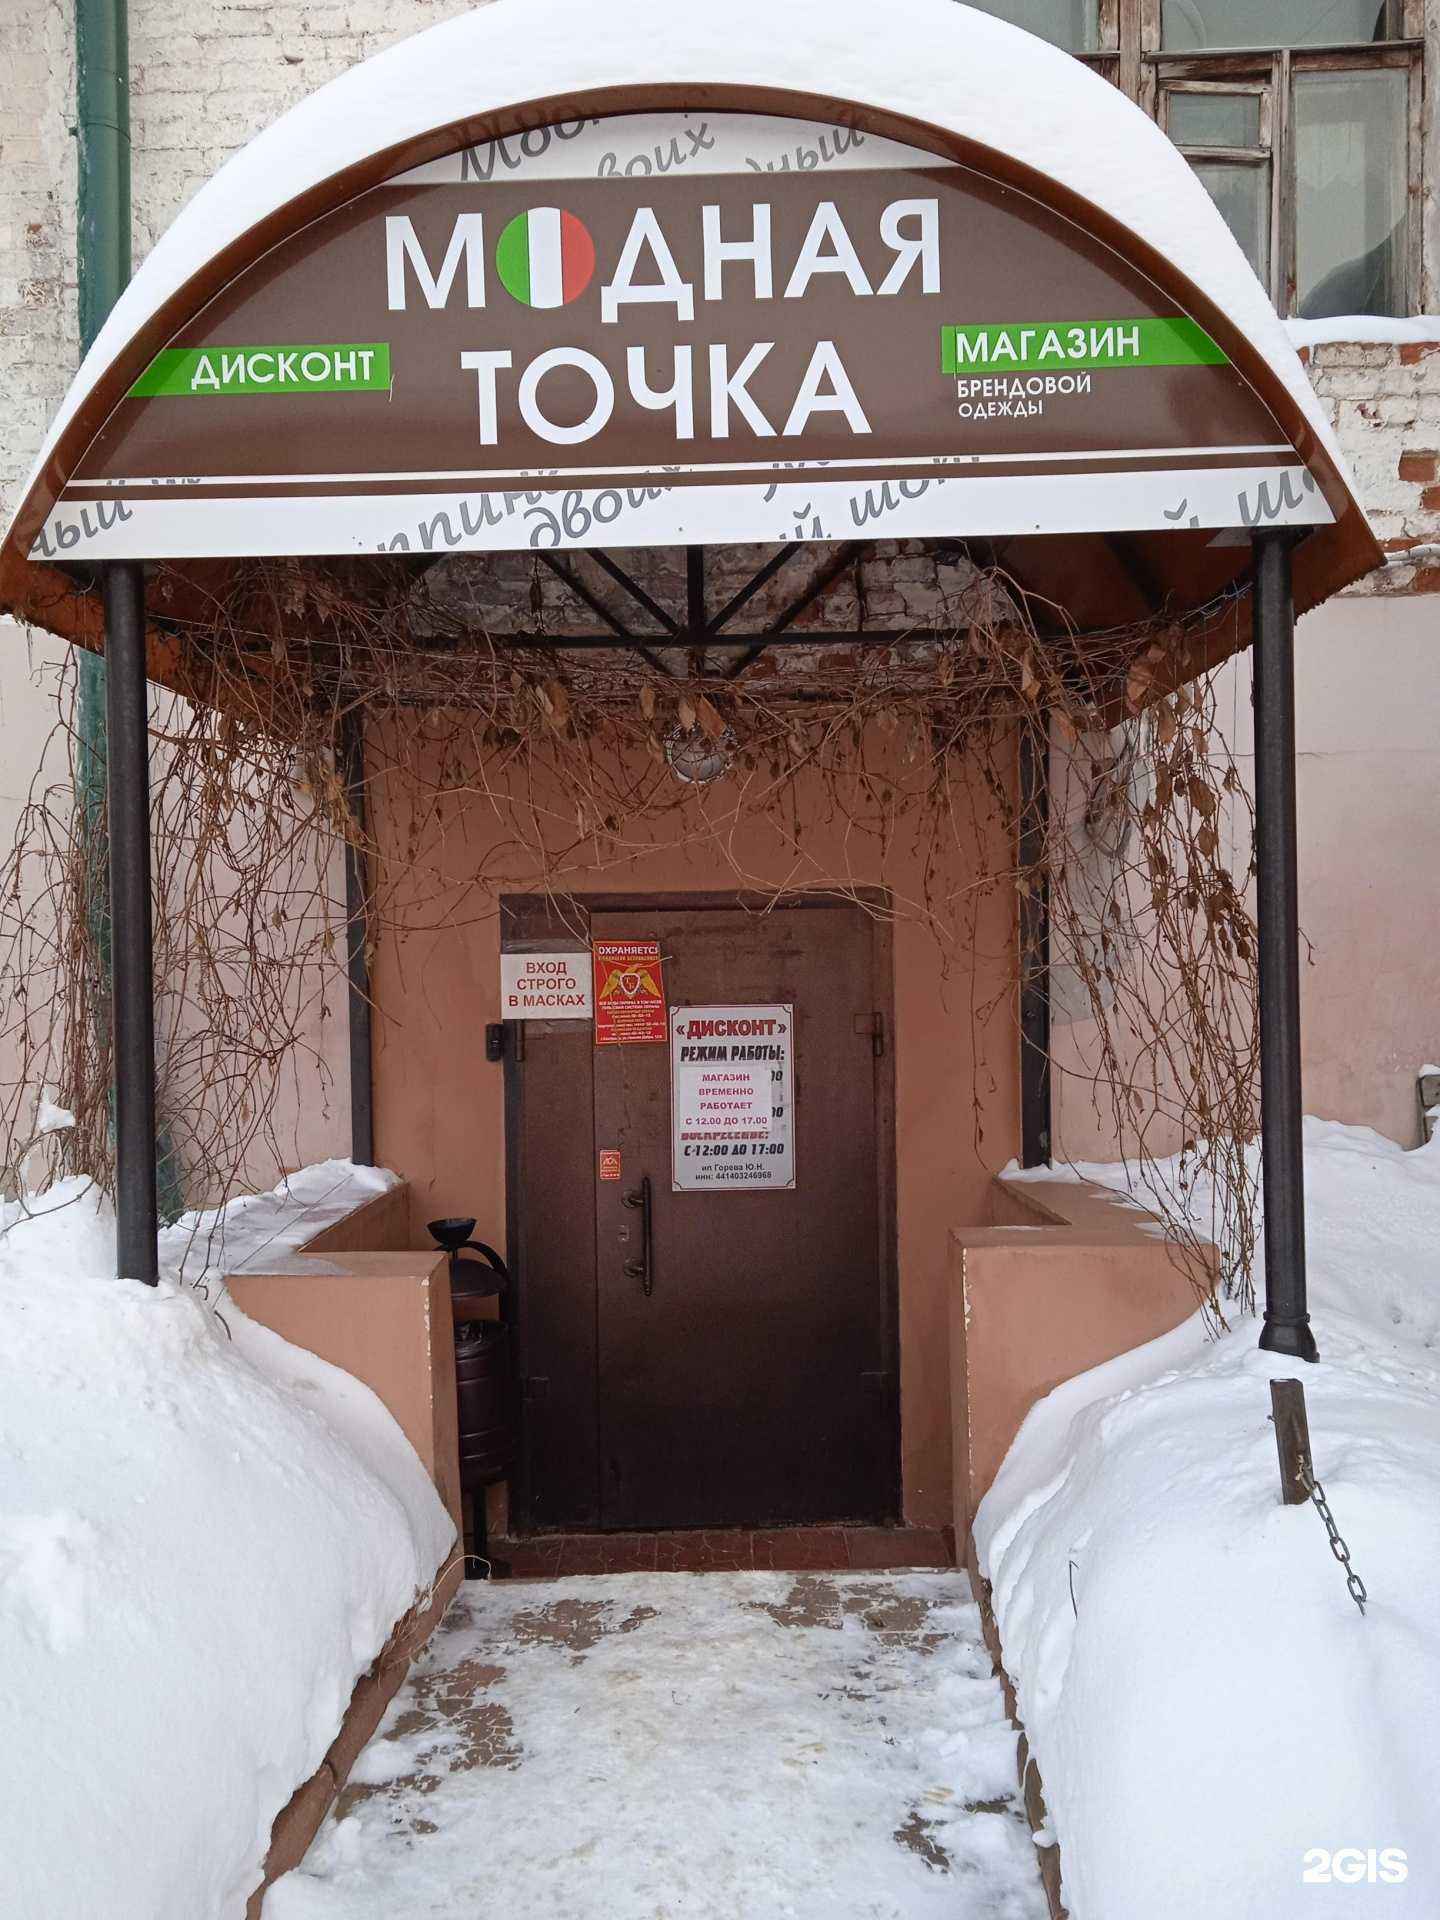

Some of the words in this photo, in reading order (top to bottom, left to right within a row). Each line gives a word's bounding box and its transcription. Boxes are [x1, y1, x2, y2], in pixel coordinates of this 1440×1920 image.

[385, 197, 942, 323] МОДНАЯ
[955, 325, 1140, 363] МАГАЗИН
[190, 349, 375, 392] ДИСКОНТ
[956, 370, 1092, 398] БРЕНДОВОЙ
[460, 340, 872, 446] ТОЧКА
[956, 398, 1044, 420] ОДЕЖДЫ
[526, 961, 567, 976] ВХОД
[516, 978, 577, 991] СТРОГО
[508, 995, 519, 1007] В
[523, 994, 585, 1007] МАСКАХ
[675, 1019, 787, 1040] «ДИСКОНТ»
[680, 1045, 728, 1062] РЕЖИМ
[731, 1044, 785, 1061] РАБОТЫ:
[702, 1073, 751, 1082] МАГАЗИН
[698, 1087, 754, 1096] ВРЕМЕННО
[699, 1101, 753, 1110] РАБОТАЕТ
[685, 1117, 693, 1125] С
[695, 1117, 721, 1125] 12.00
[723, 1117, 738, 1126] ДО
[742, 1116, 768, 1125] 17.00
[731, 1143, 747, 1156] ДО
[751, 1143, 785, 1156] 17:00
